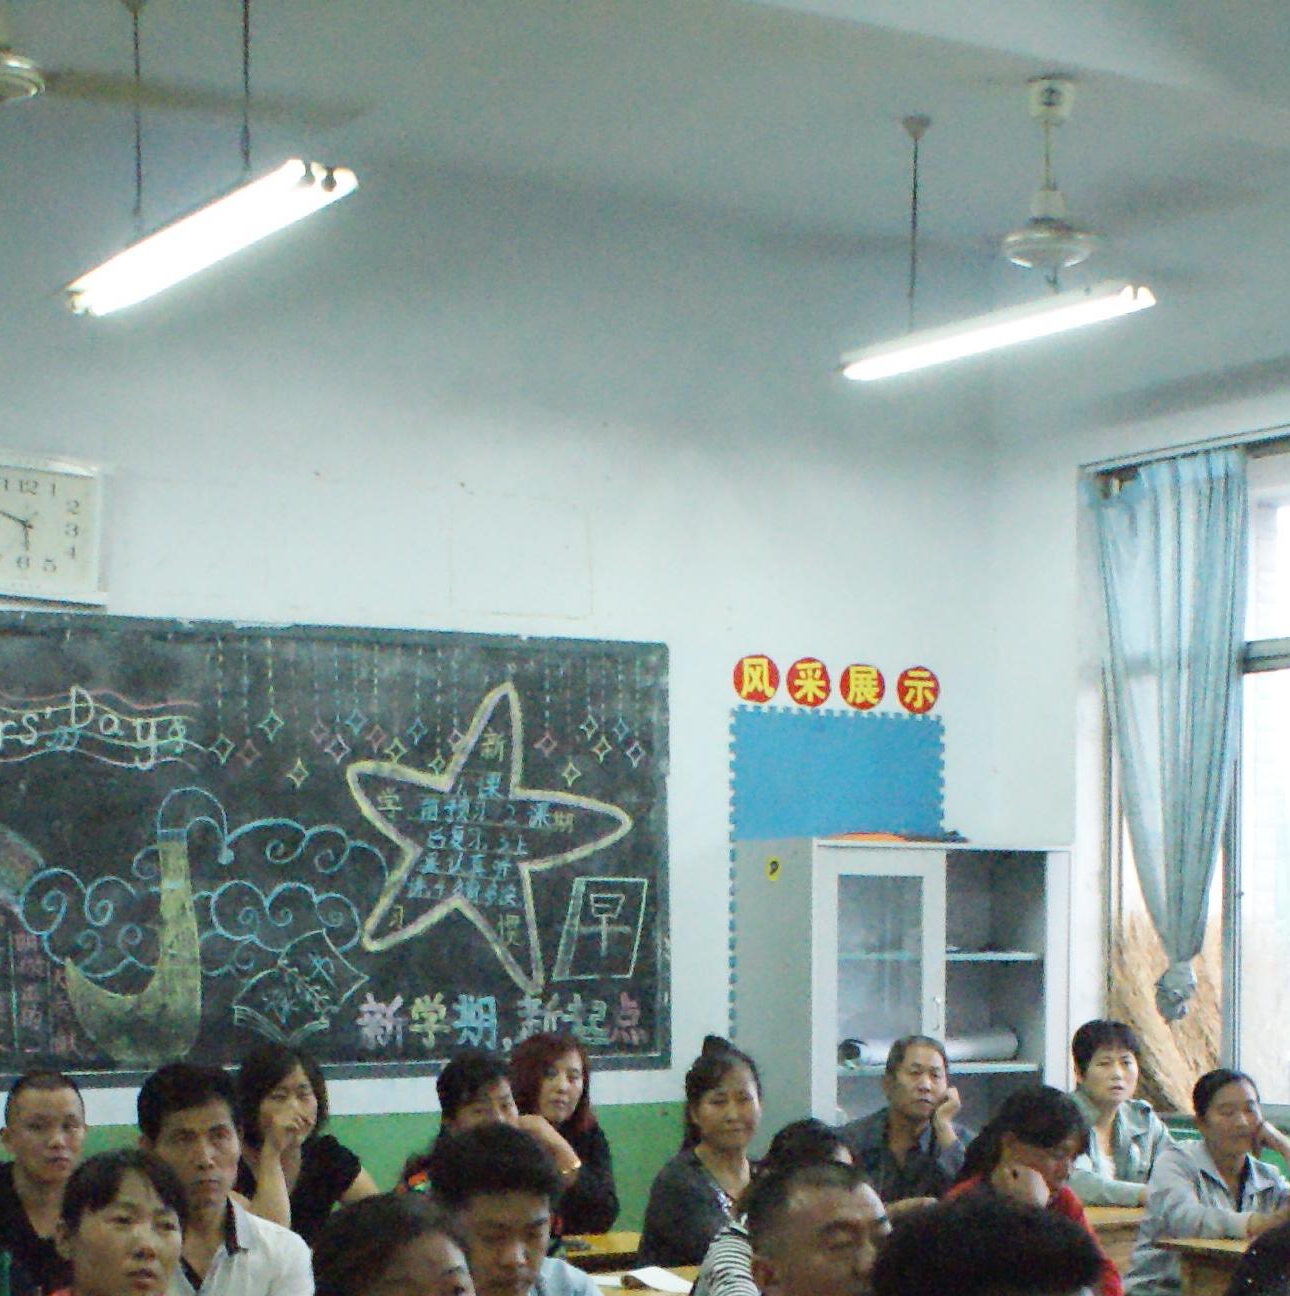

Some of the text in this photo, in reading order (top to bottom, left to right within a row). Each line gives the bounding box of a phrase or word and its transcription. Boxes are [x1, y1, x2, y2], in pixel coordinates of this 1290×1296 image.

[741, 657, 935, 709] 风采展示
[70, 684, 157, 771] Day
